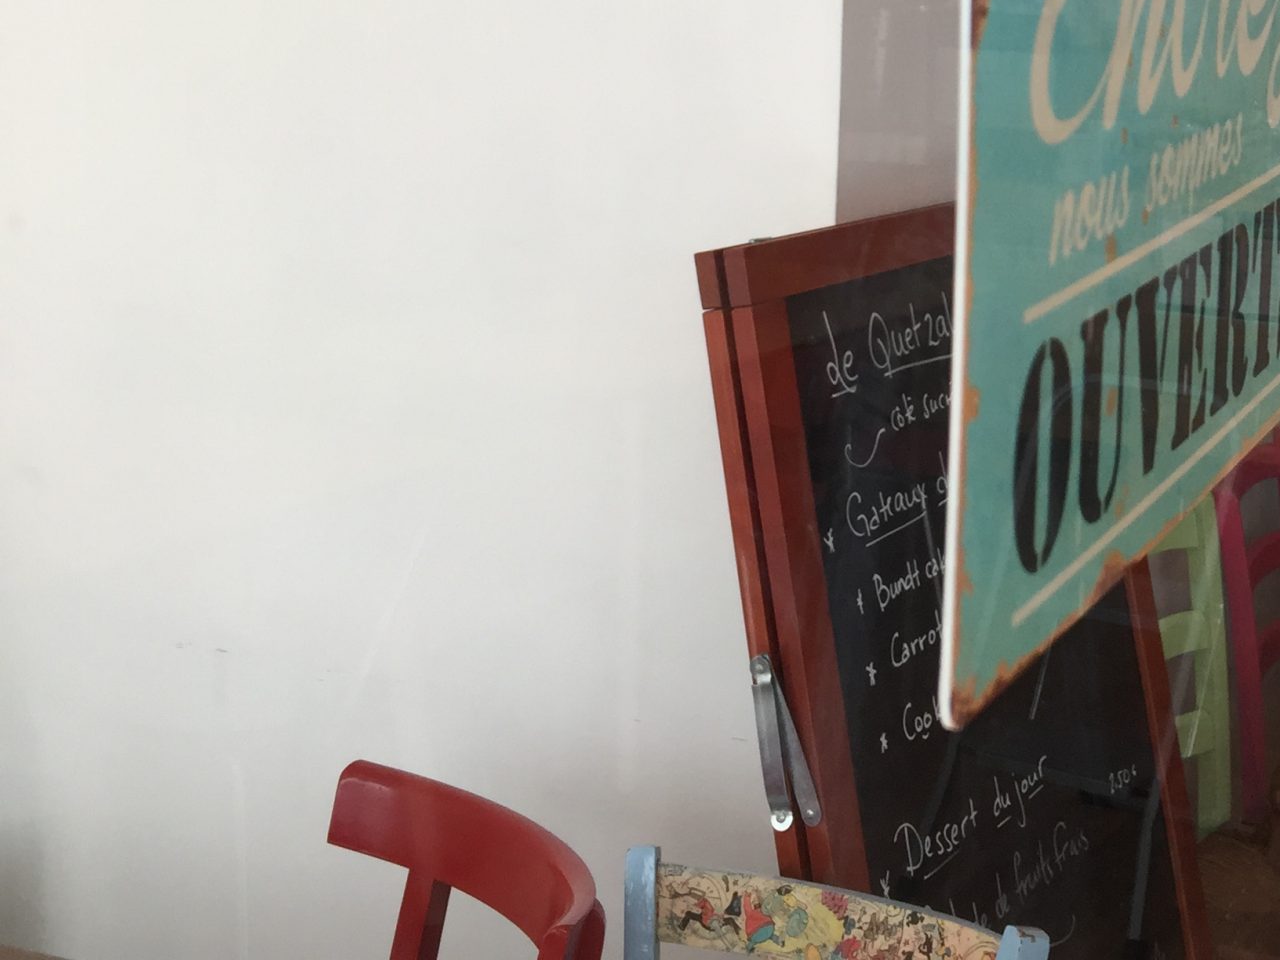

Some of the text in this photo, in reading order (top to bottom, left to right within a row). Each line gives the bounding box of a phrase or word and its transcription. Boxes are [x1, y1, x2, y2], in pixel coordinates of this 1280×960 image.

[1049, 112, 1244, 268] nous sommes
[822, 309, 859, 394] de
[924, 547, 946, 579] cak
[890, 608, 943, 668] Carrot
[893, 754, 1048, 877] Dessert du jour
